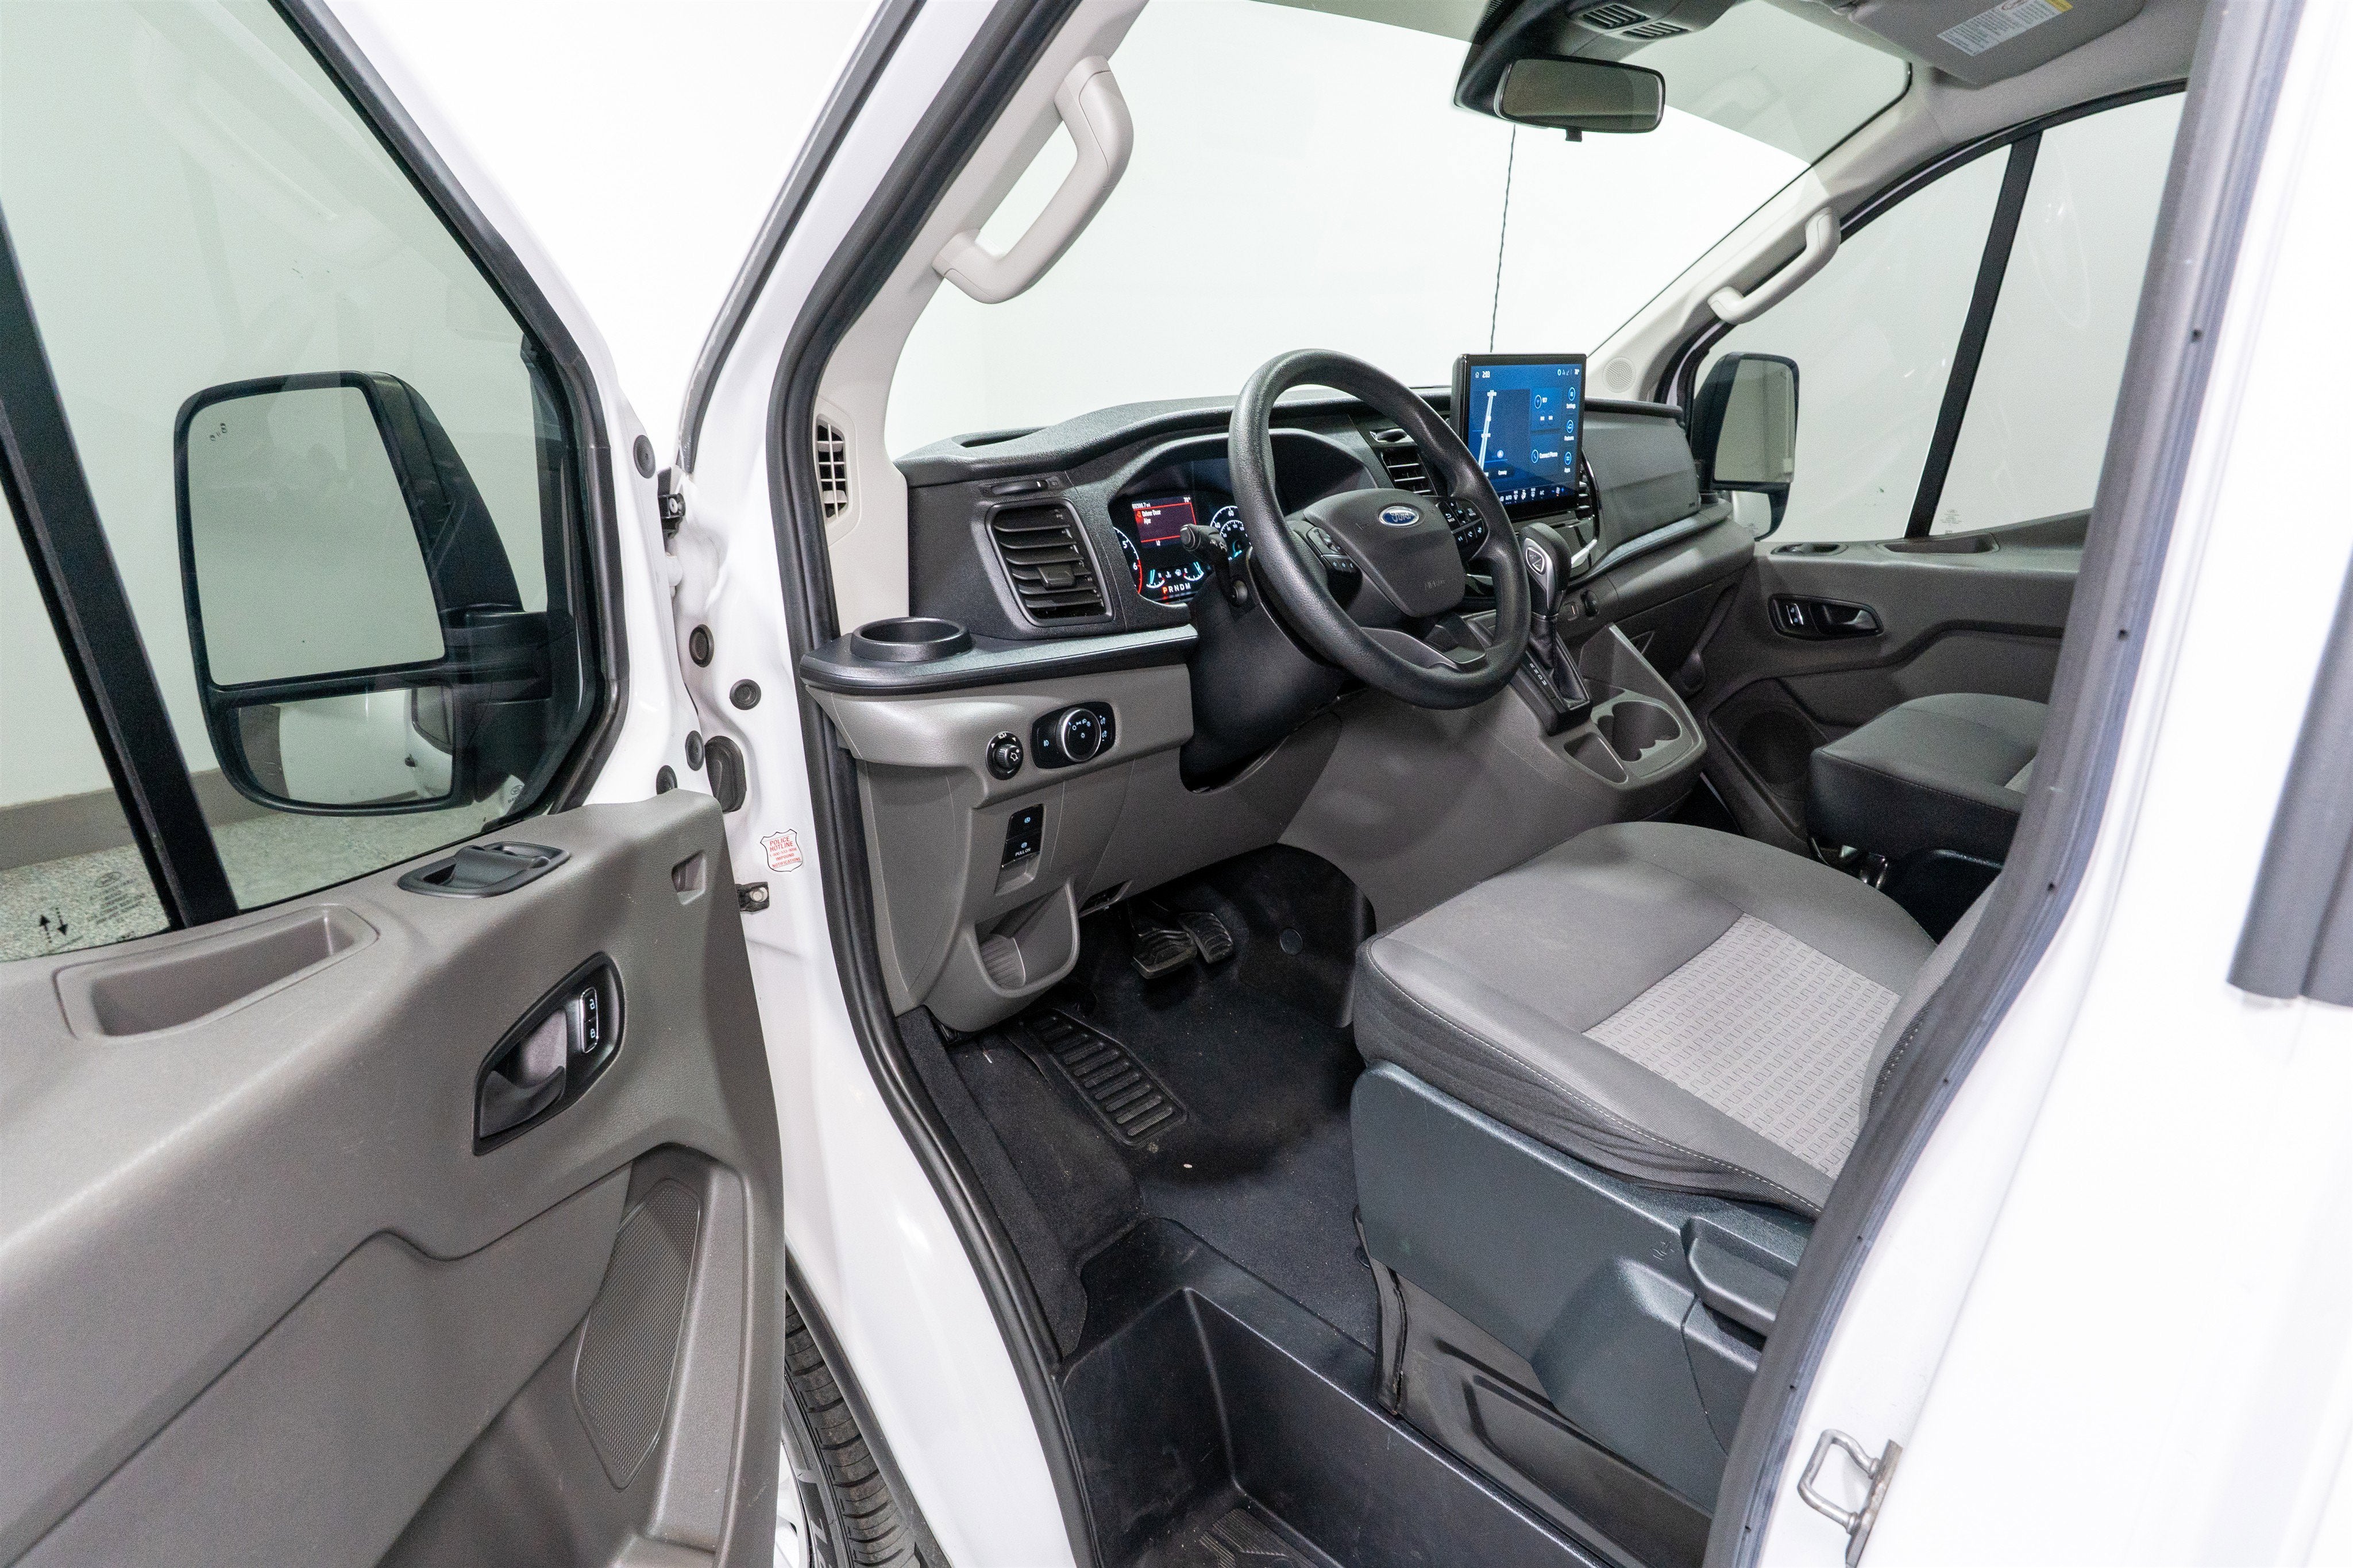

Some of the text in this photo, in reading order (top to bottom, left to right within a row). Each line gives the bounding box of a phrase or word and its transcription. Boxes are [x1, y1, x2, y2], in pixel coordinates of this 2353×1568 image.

[1390, 512, 1411, 522] Ford
[1122, 540, 1128, 549] 5
[1132, 562, 1138, 570] 6
[769, 836, 790, 846] POLICE
[770, 841, 793, 852] HOTLINE
[776, 853, 794, 861] IMPOUND
[772, 857, 801, 868] NOTIFICATIONS
